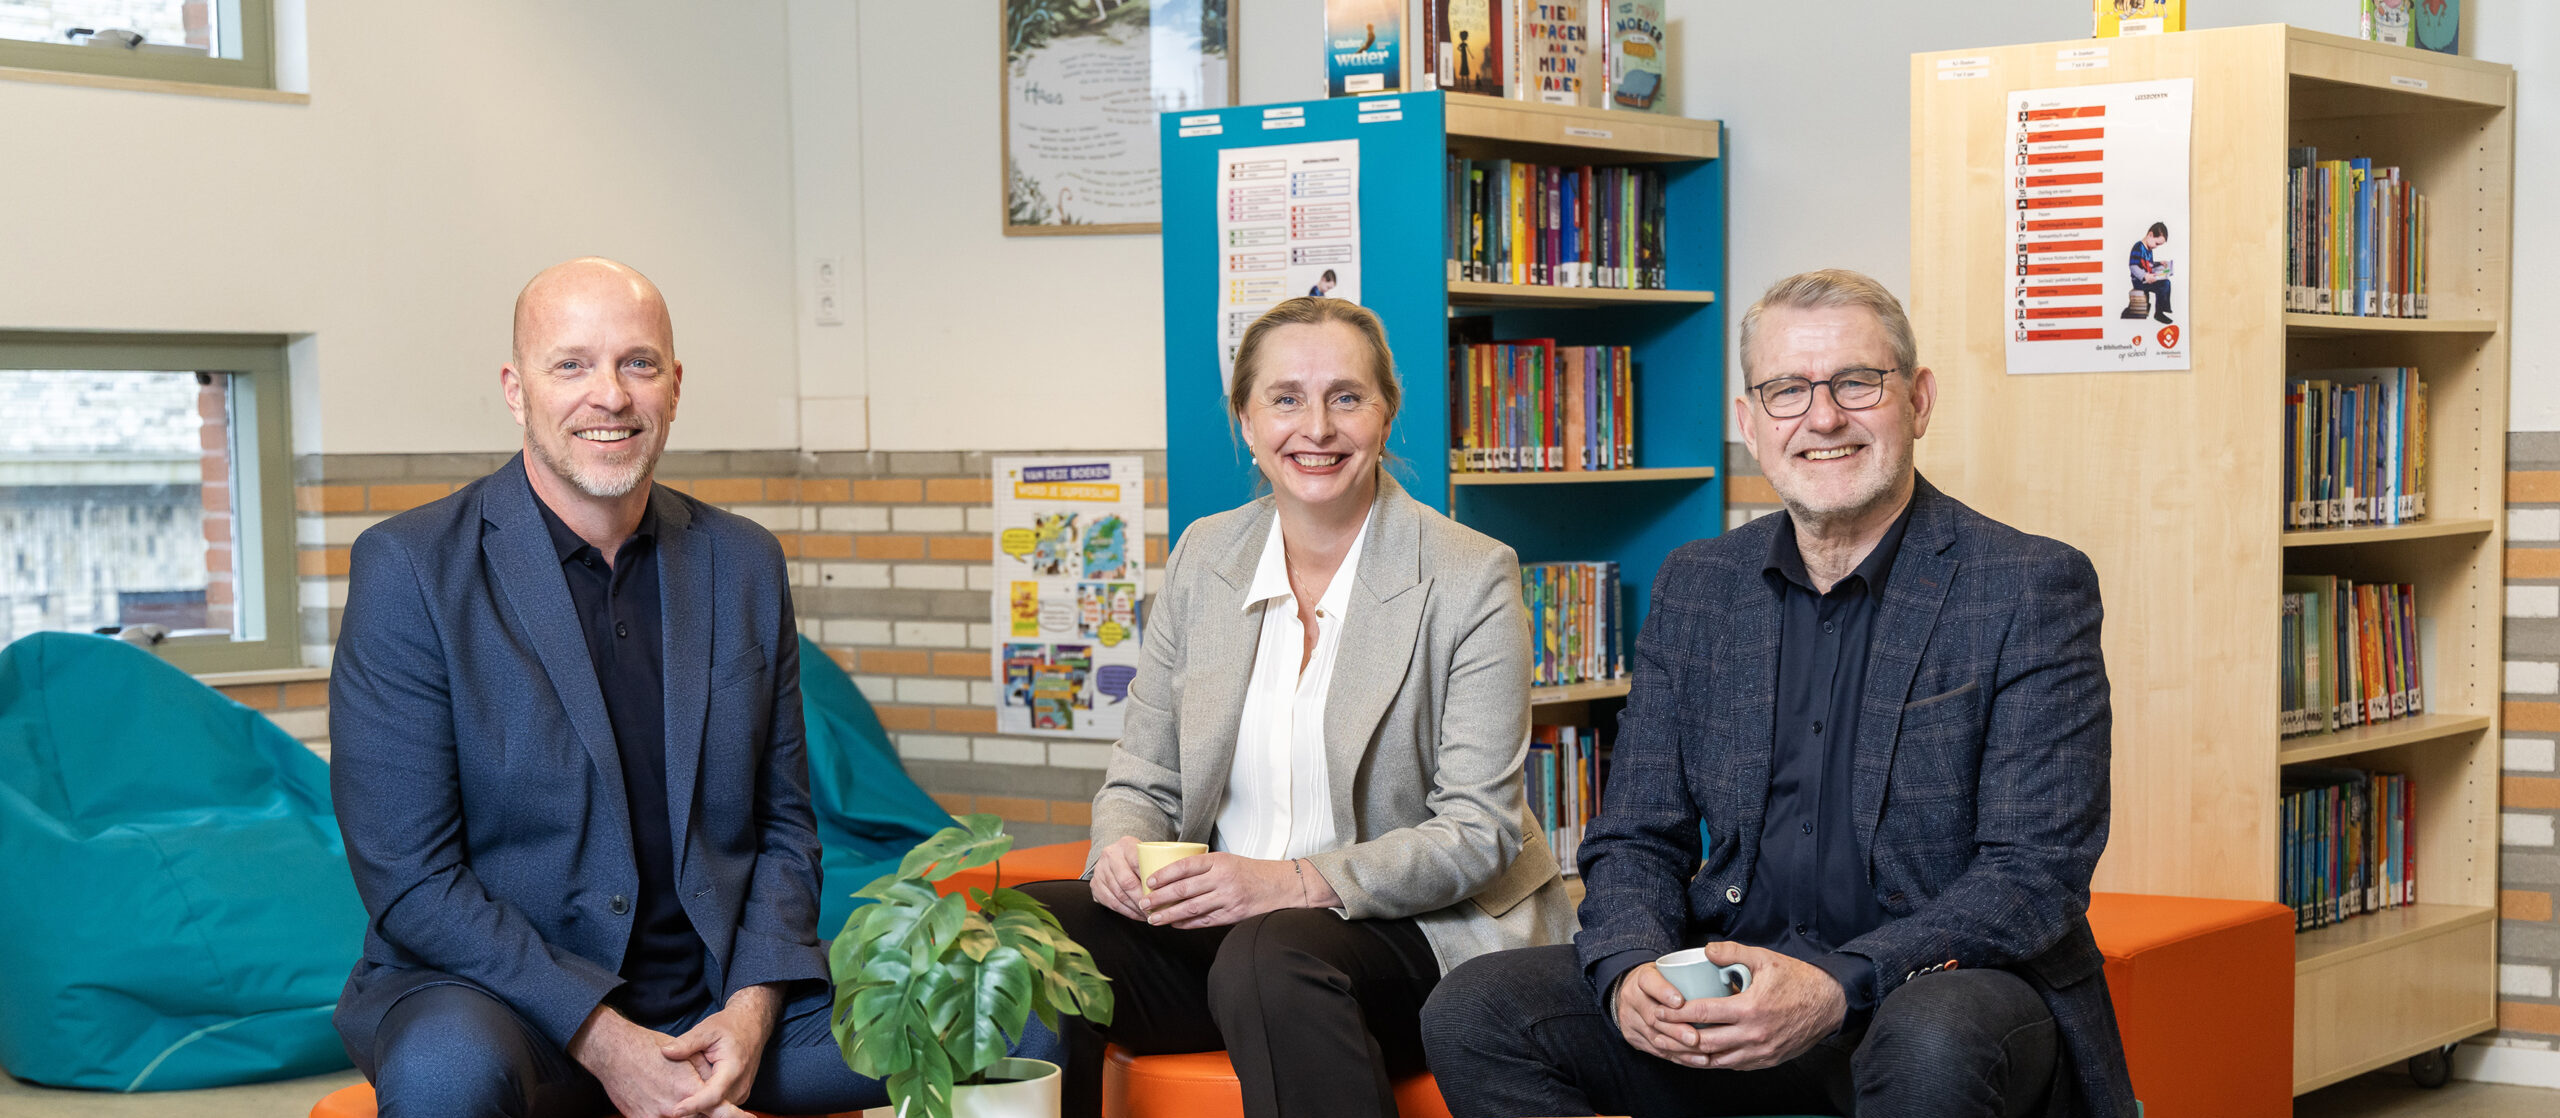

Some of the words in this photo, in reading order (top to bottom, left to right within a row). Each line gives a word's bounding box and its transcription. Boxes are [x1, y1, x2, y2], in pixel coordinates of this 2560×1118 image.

[1539, 5, 1577, 21] TIEN
[1529, 23, 1586, 41] VRAGEN
[1616, 17, 1663, 43] MOEDER
[1549, 43, 1568, 53] AAN
[1334, 50, 1389, 67] water
[1539, 57, 1577, 74] MIJN
[1534, 74, 1583, 94] VADER
[2127, 347, 2147, 358] school
